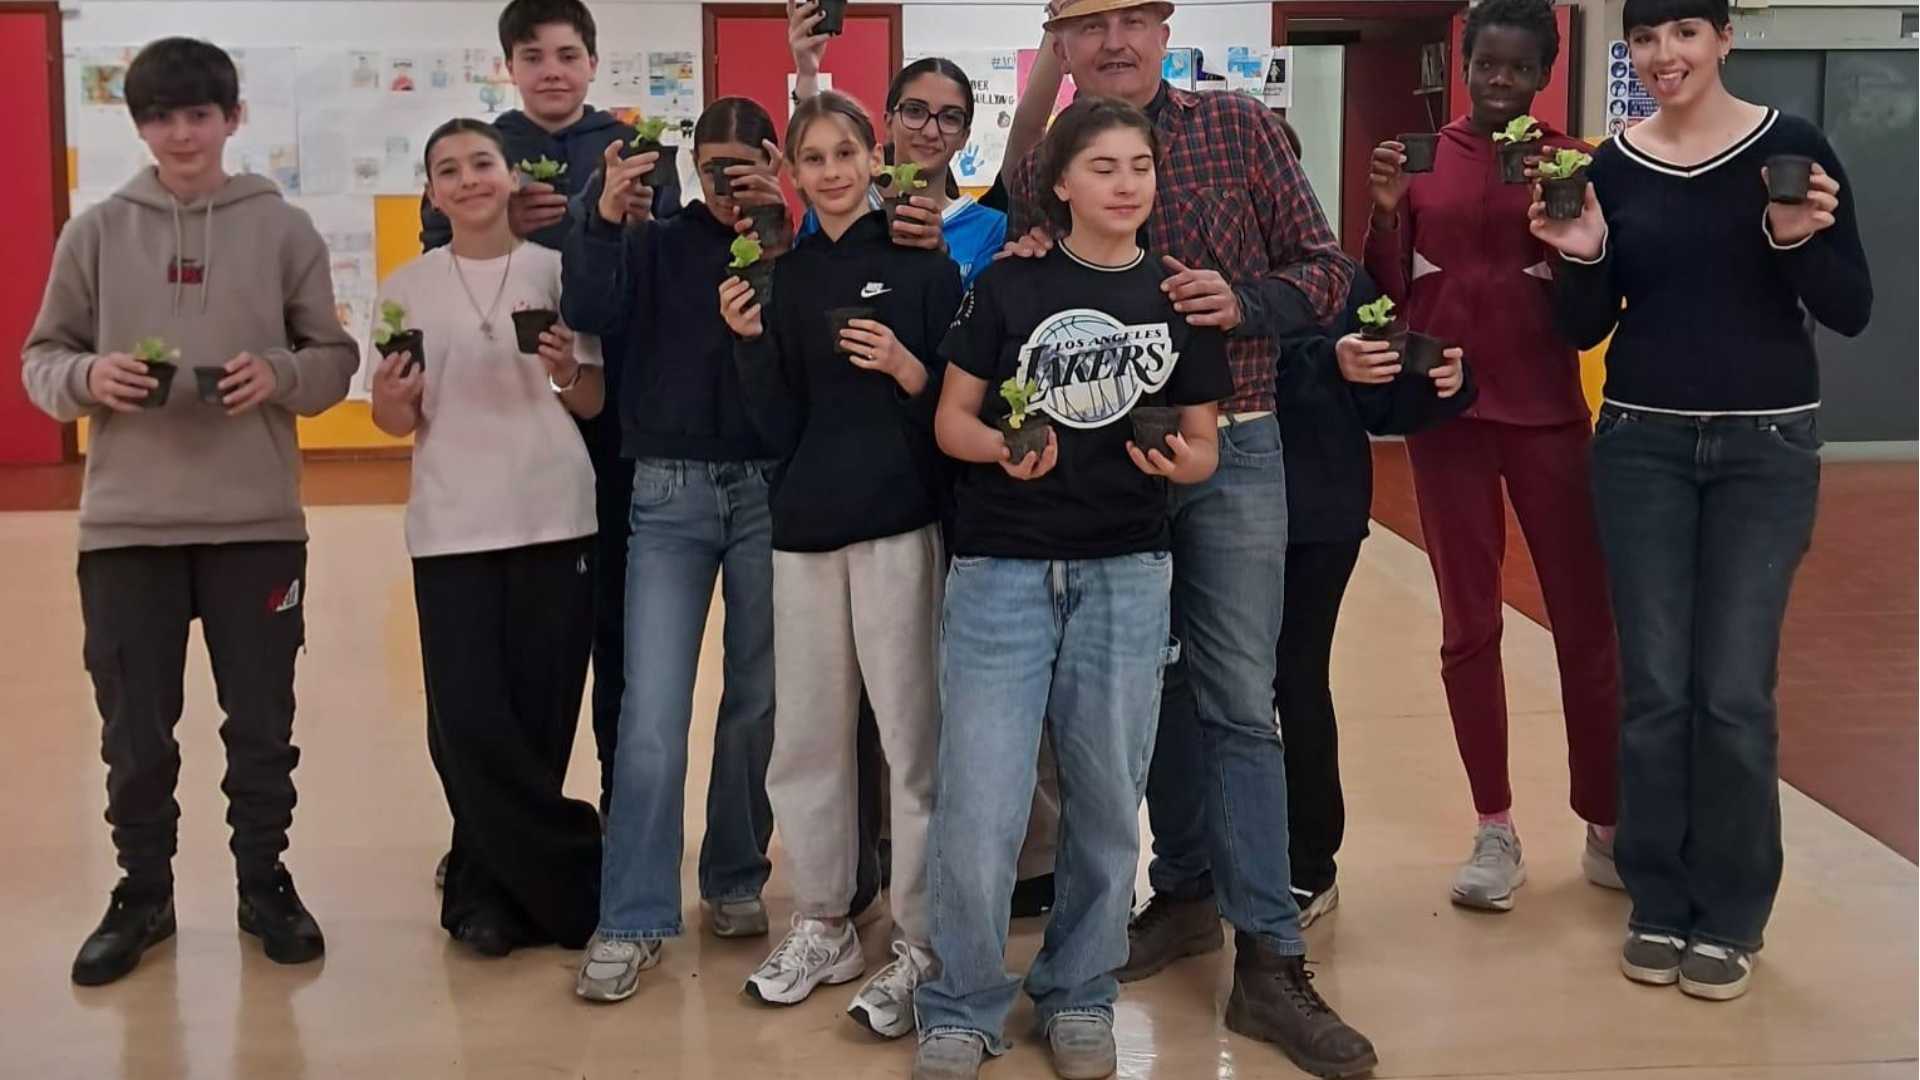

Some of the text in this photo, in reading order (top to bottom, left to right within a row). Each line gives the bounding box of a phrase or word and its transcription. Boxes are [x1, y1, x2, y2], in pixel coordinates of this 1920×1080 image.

[970, 80, 988, 91] BER
[1055, 328, 1163, 352] LOS ANGELES
[1025, 342, 1166, 403] LAKERS
